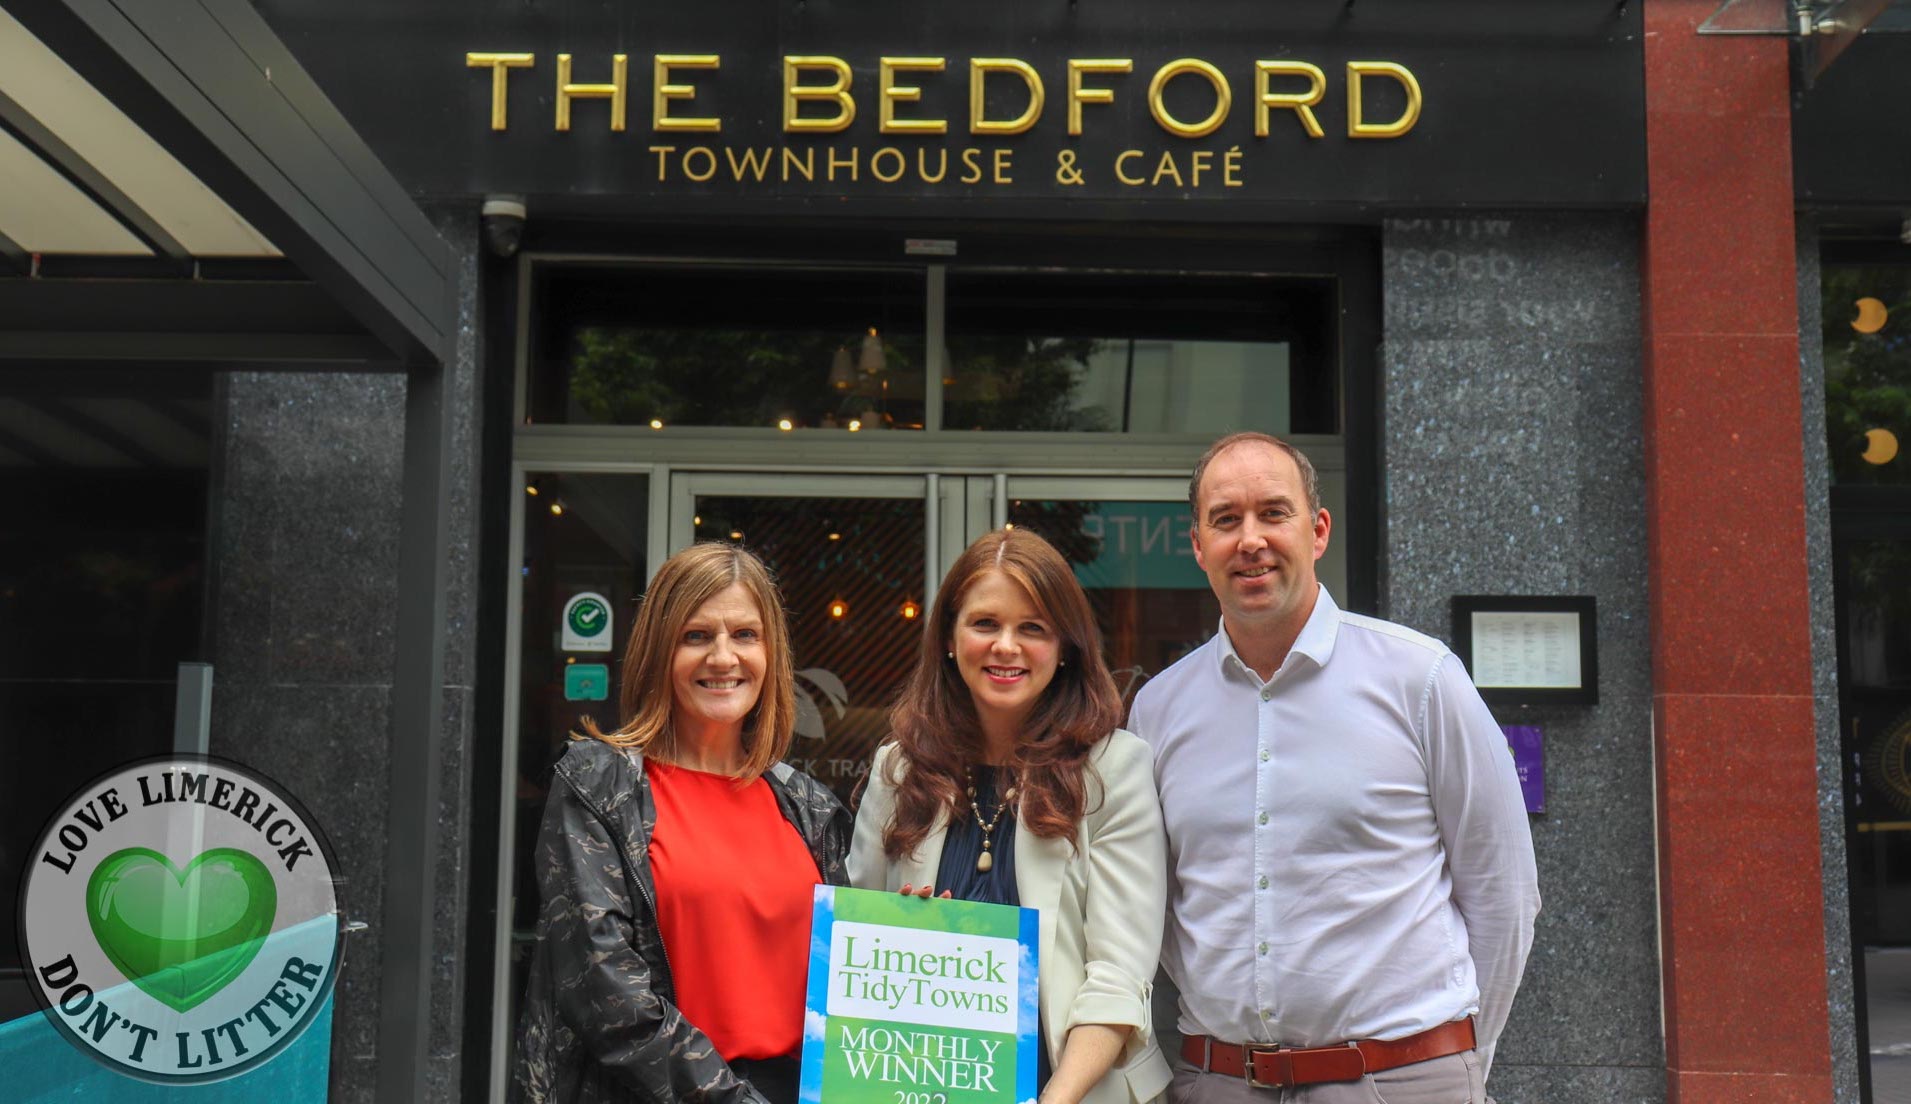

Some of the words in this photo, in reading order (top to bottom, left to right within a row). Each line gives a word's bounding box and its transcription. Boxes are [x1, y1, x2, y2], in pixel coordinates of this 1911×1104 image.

[466, 52, 721, 131] THE
[783, 55, 1422, 138] BEDFORD
[649, 146, 1013, 184] TOWNHOUSE
[1056, 149, 1085, 184] &
[1115, 146, 1244, 187] CAFÉ
[842, 936, 1007, 984] Limerick
[838, 970, 1009, 1015] TidyTowns
[839, 1025, 1003, 1063] MONTHLY
[843, 1050, 999, 1093] WINNER
